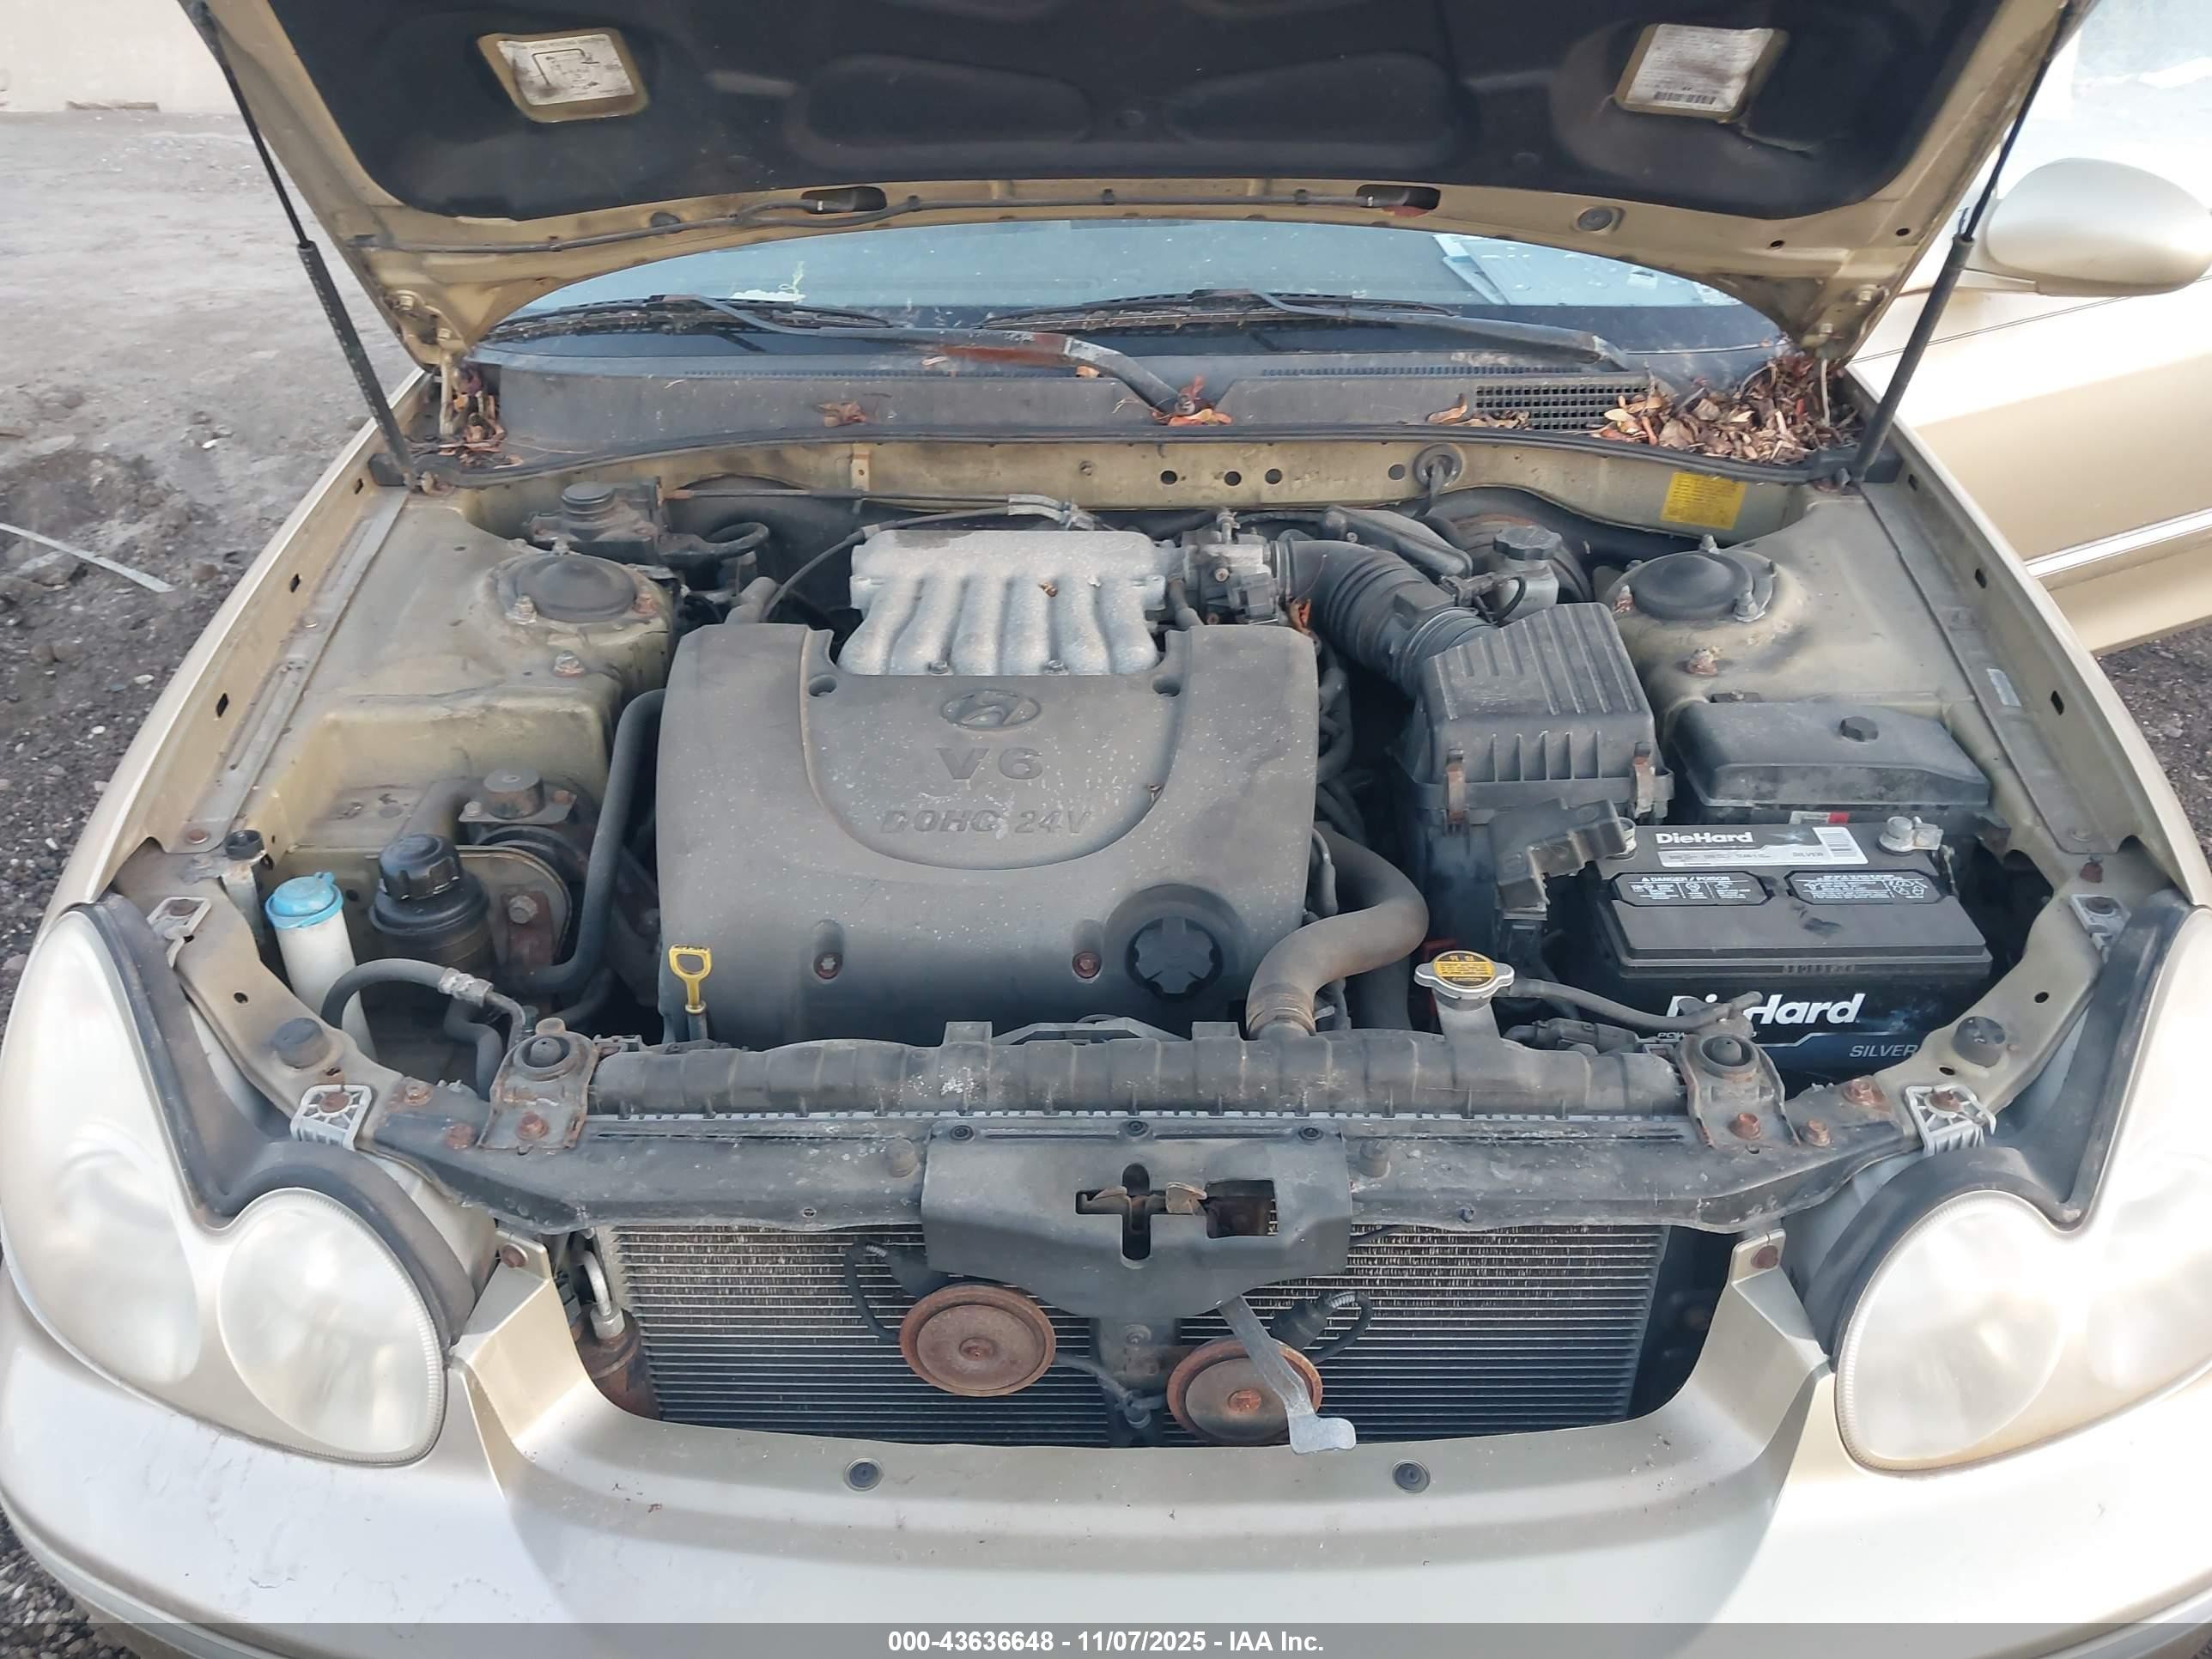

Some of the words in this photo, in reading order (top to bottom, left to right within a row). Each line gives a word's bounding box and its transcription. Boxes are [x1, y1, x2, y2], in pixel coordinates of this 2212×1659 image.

[936, 747, 1043, 780] V6
[881, 810, 1002, 833] DOHC
[1015, 810, 1091, 833] 24V
[1656, 831, 1754, 844] DieHard
[1667, 993, 1866, 1024] Hard
[1849, 1044, 1919, 1058] SILVER
